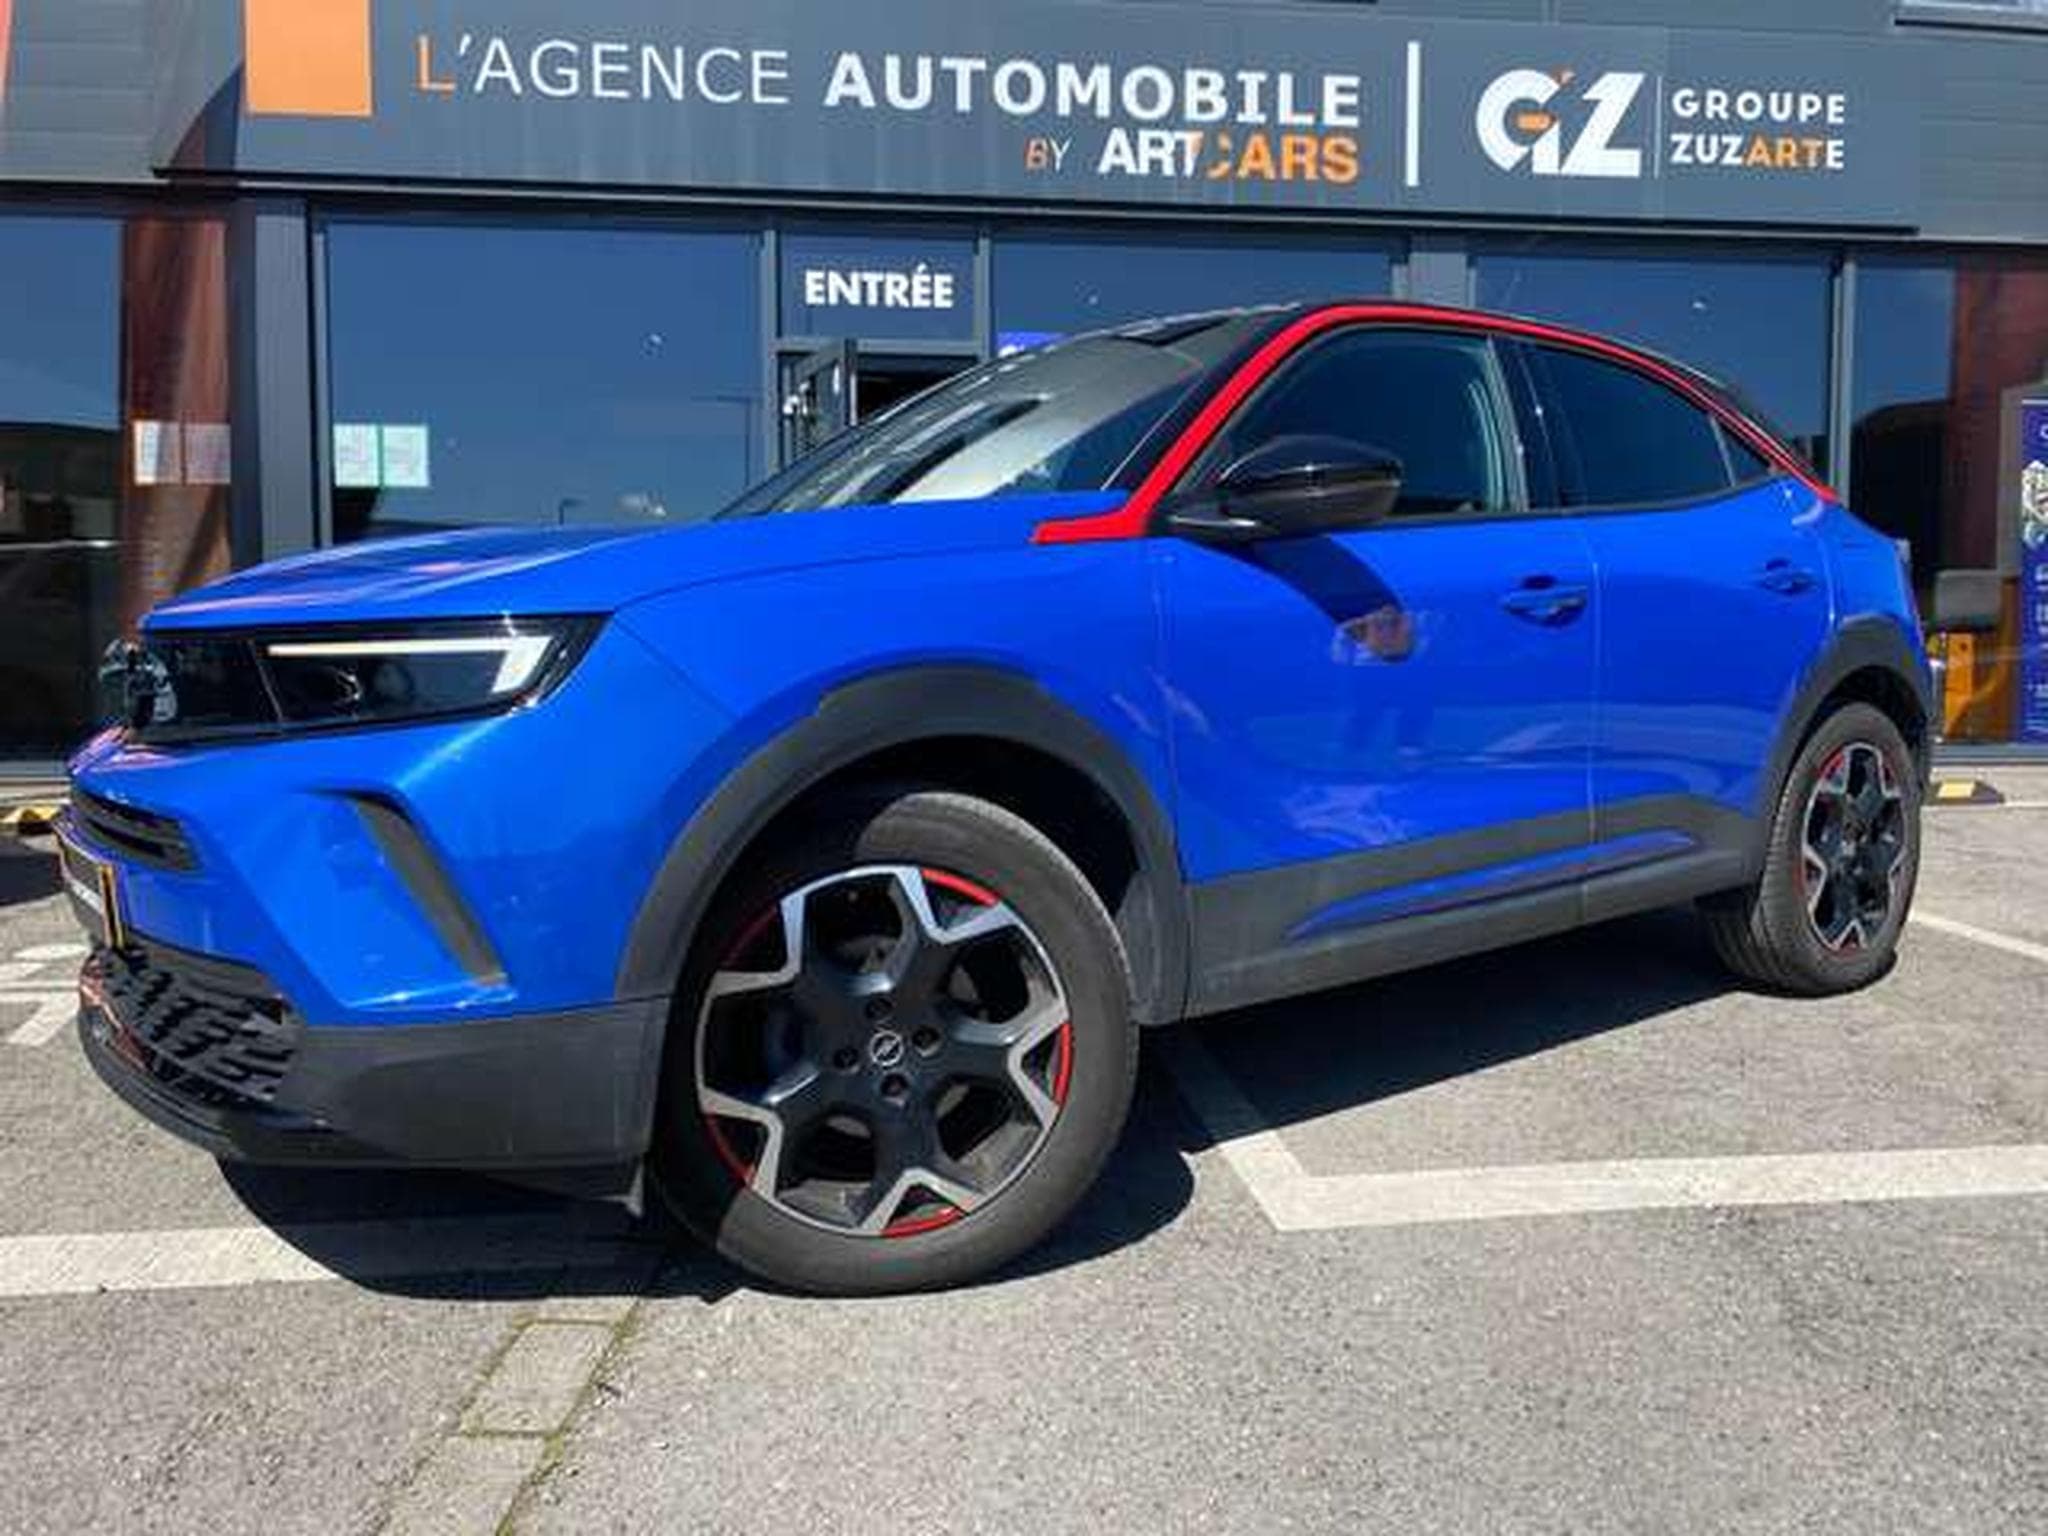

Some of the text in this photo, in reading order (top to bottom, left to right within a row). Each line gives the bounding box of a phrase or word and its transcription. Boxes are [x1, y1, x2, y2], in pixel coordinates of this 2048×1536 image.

[415, 34, 1361, 127] L'AGENCE AUTOMOBILE
[1671, 87, 1846, 125] GROUPE
[1024, 136, 1071, 174] BY
[1669, 132, 1845, 170] ZUZARTE
[804, 262, 955, 309] ENTRÉE
